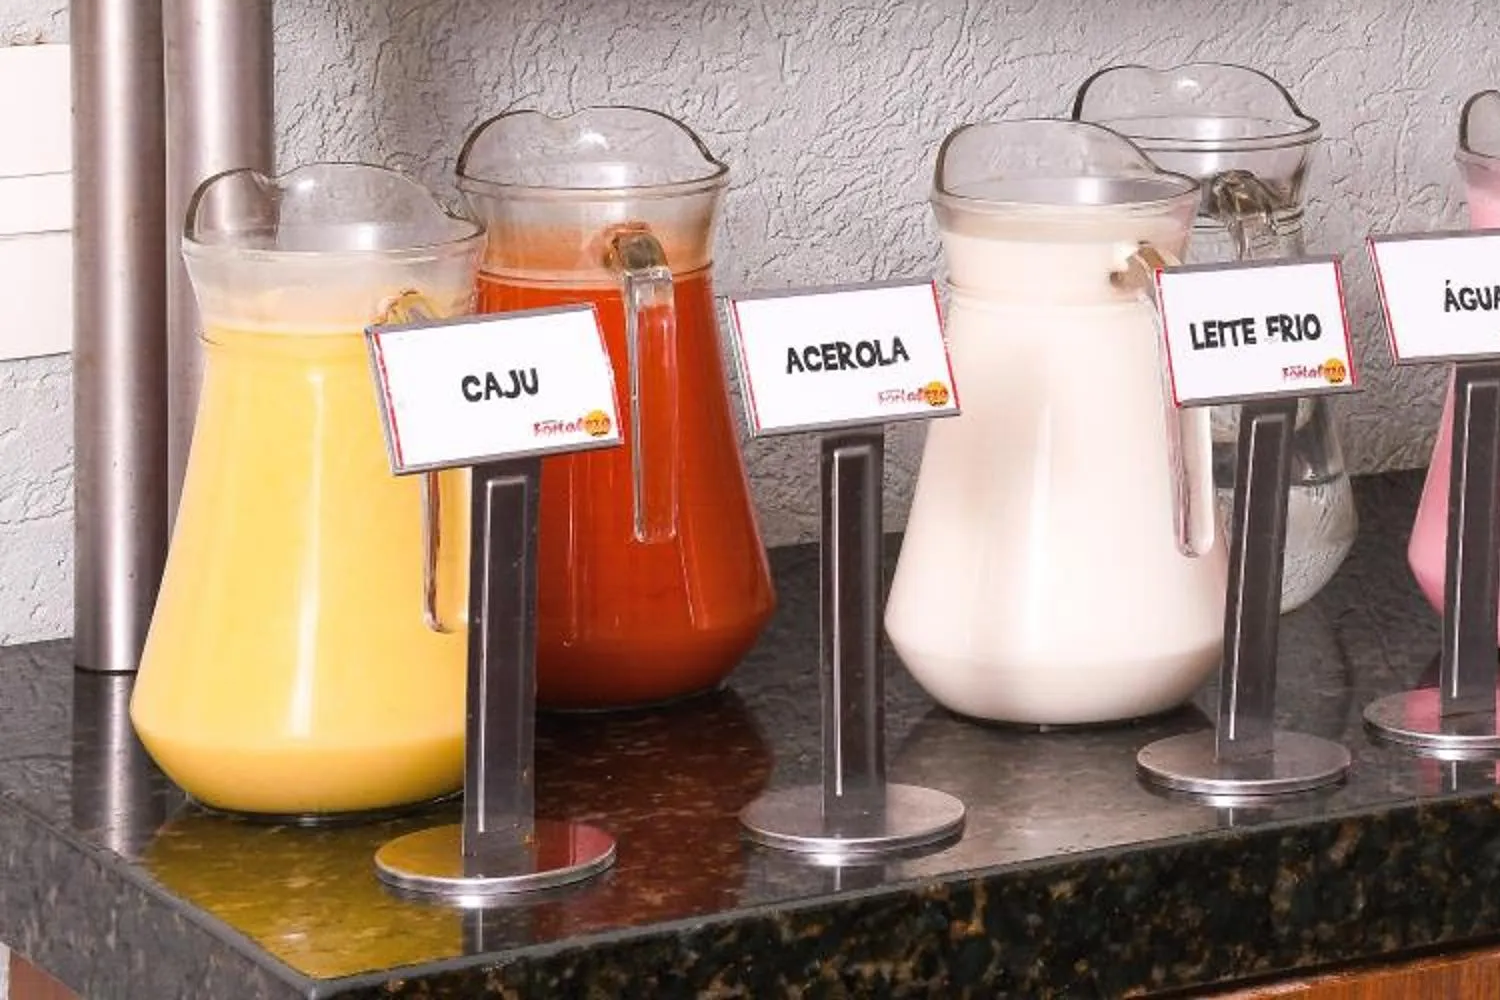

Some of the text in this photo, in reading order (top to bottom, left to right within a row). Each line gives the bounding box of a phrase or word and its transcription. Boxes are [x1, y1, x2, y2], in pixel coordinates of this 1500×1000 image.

[1189, 313, 1322, 350] LEITE FRIO
[786, 336, 909, 375] ACEROLA
[461, 368, 539, 402] CAJU
